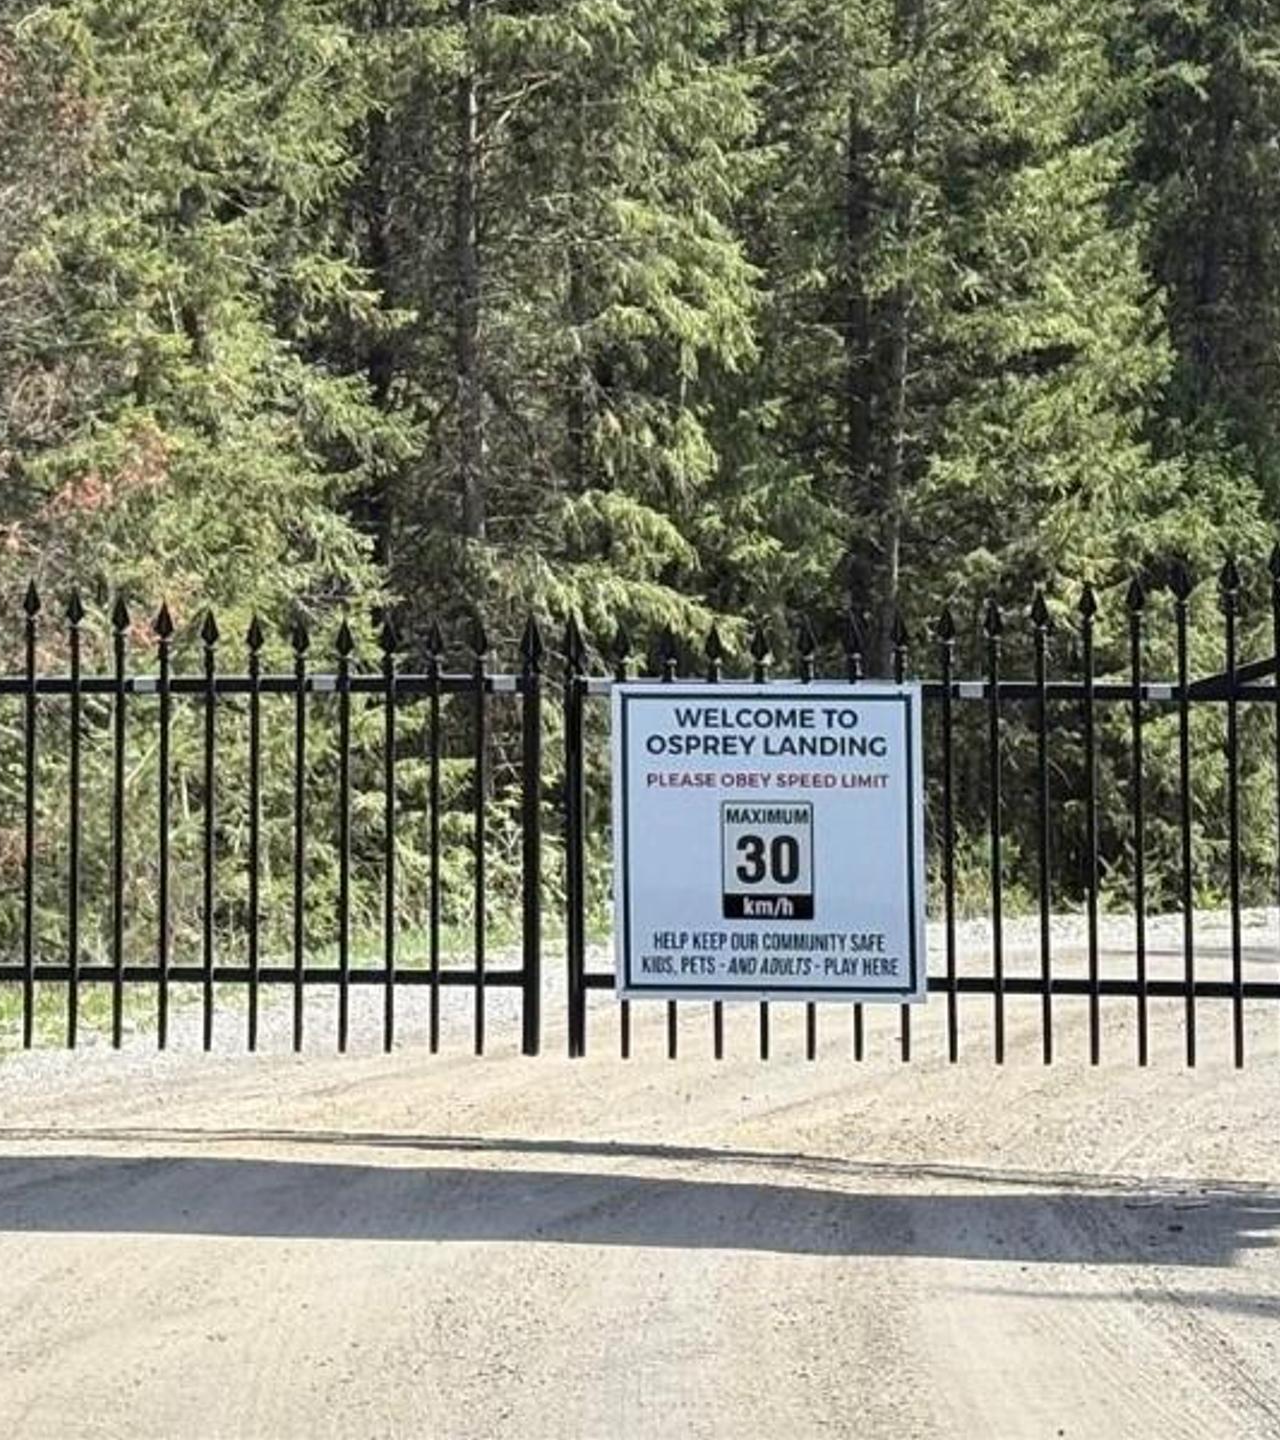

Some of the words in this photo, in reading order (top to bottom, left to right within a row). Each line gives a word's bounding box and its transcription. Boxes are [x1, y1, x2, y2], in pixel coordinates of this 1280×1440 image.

[674, 708, 815, 729] WELCOME
[821, 709, 858, 729] TO
[646, 734, 756, 756] OSPREY
[763, 736, 887, 758] LANDING
[647, 773, 716, 788] PLEASE
[721, 773, 771, 788] OBEY
[776, 773, 837, 789] SPEED
[841, 774, 889, 789] LIMIT
[726, 808, 809, 825] MAXIMUM
[736, 835, 800, 884] 30
[743, 896, 794, 917] km/h
[654, 931, 689, 950] HELP
[693, 932, 727, 951] KEEP
[731, 932, 758, 951] OUR
[762, 933, 847, 953] COMMUNITY
[851, 934, 885, 953] SAFE
[641, 956, 677, 976] KIDS,
[681, 956, 715, 975] PETS
[728, 957, 756, 976] AND
[760, 957, 811, 976] ADULTS
[824, 958, 858, 976] PLAY
[862, 958, 899, 977] HERE
